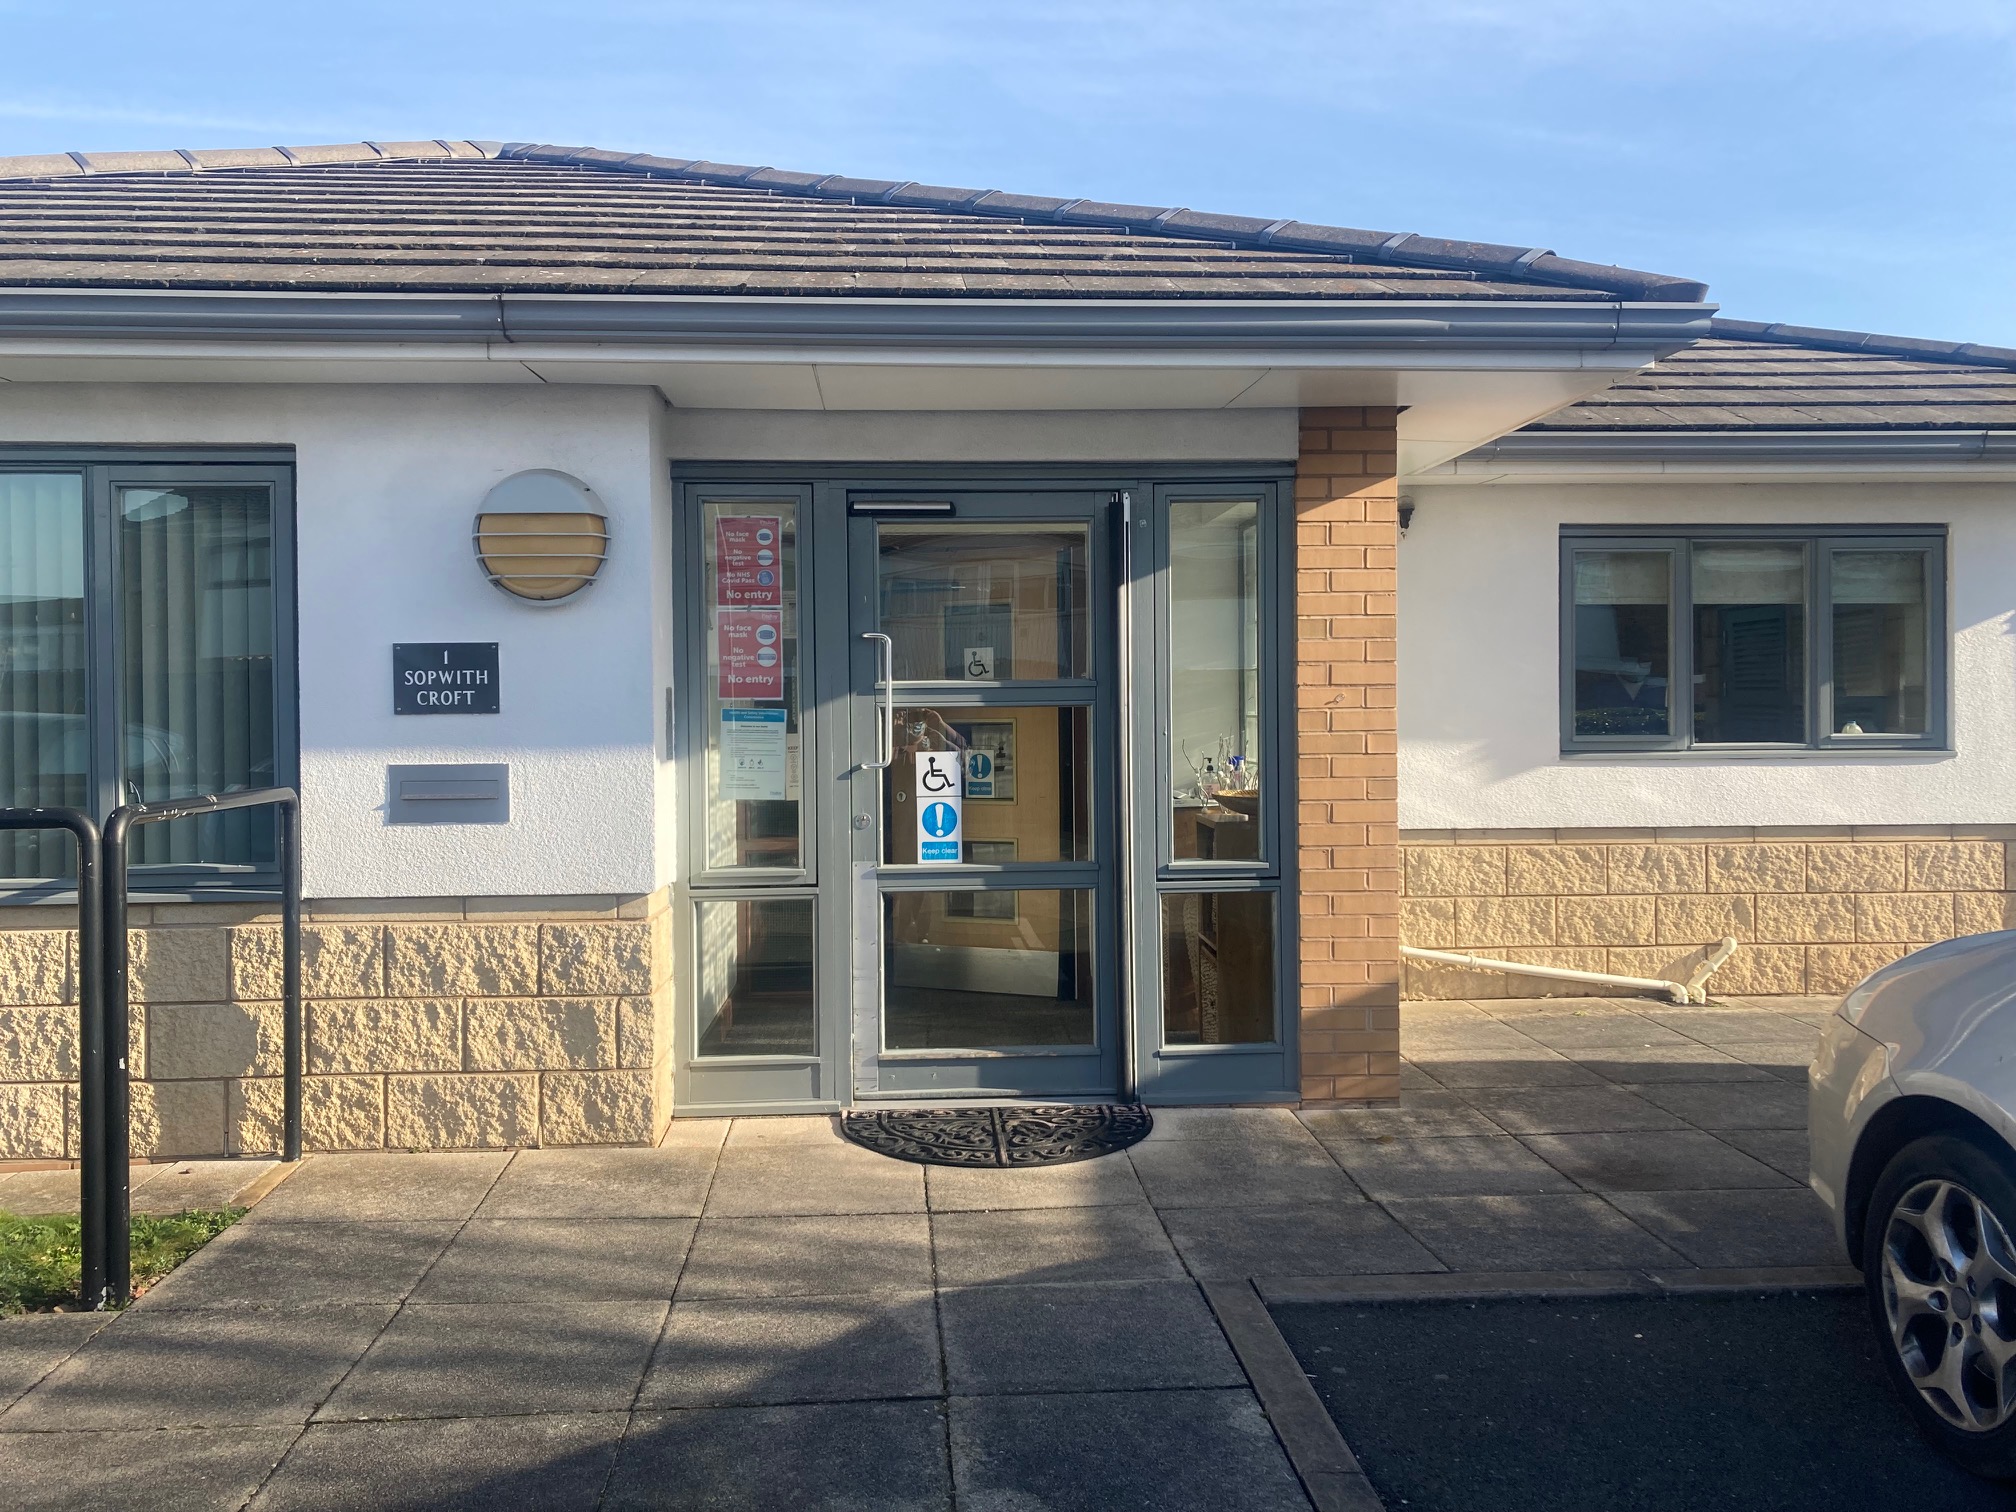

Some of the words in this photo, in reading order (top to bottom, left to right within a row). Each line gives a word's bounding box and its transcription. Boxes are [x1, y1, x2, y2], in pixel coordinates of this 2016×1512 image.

[726, 589, 742, 599] No
[744, 590, 773, 601] entry
[404, 669, 488, 686] SOPWITH
[727, 674, 743, 684] No
[745, 675, 774, 686] entry
[416, 690, 476, 706] CROFT
[922, 847, 940, 855] Keep
